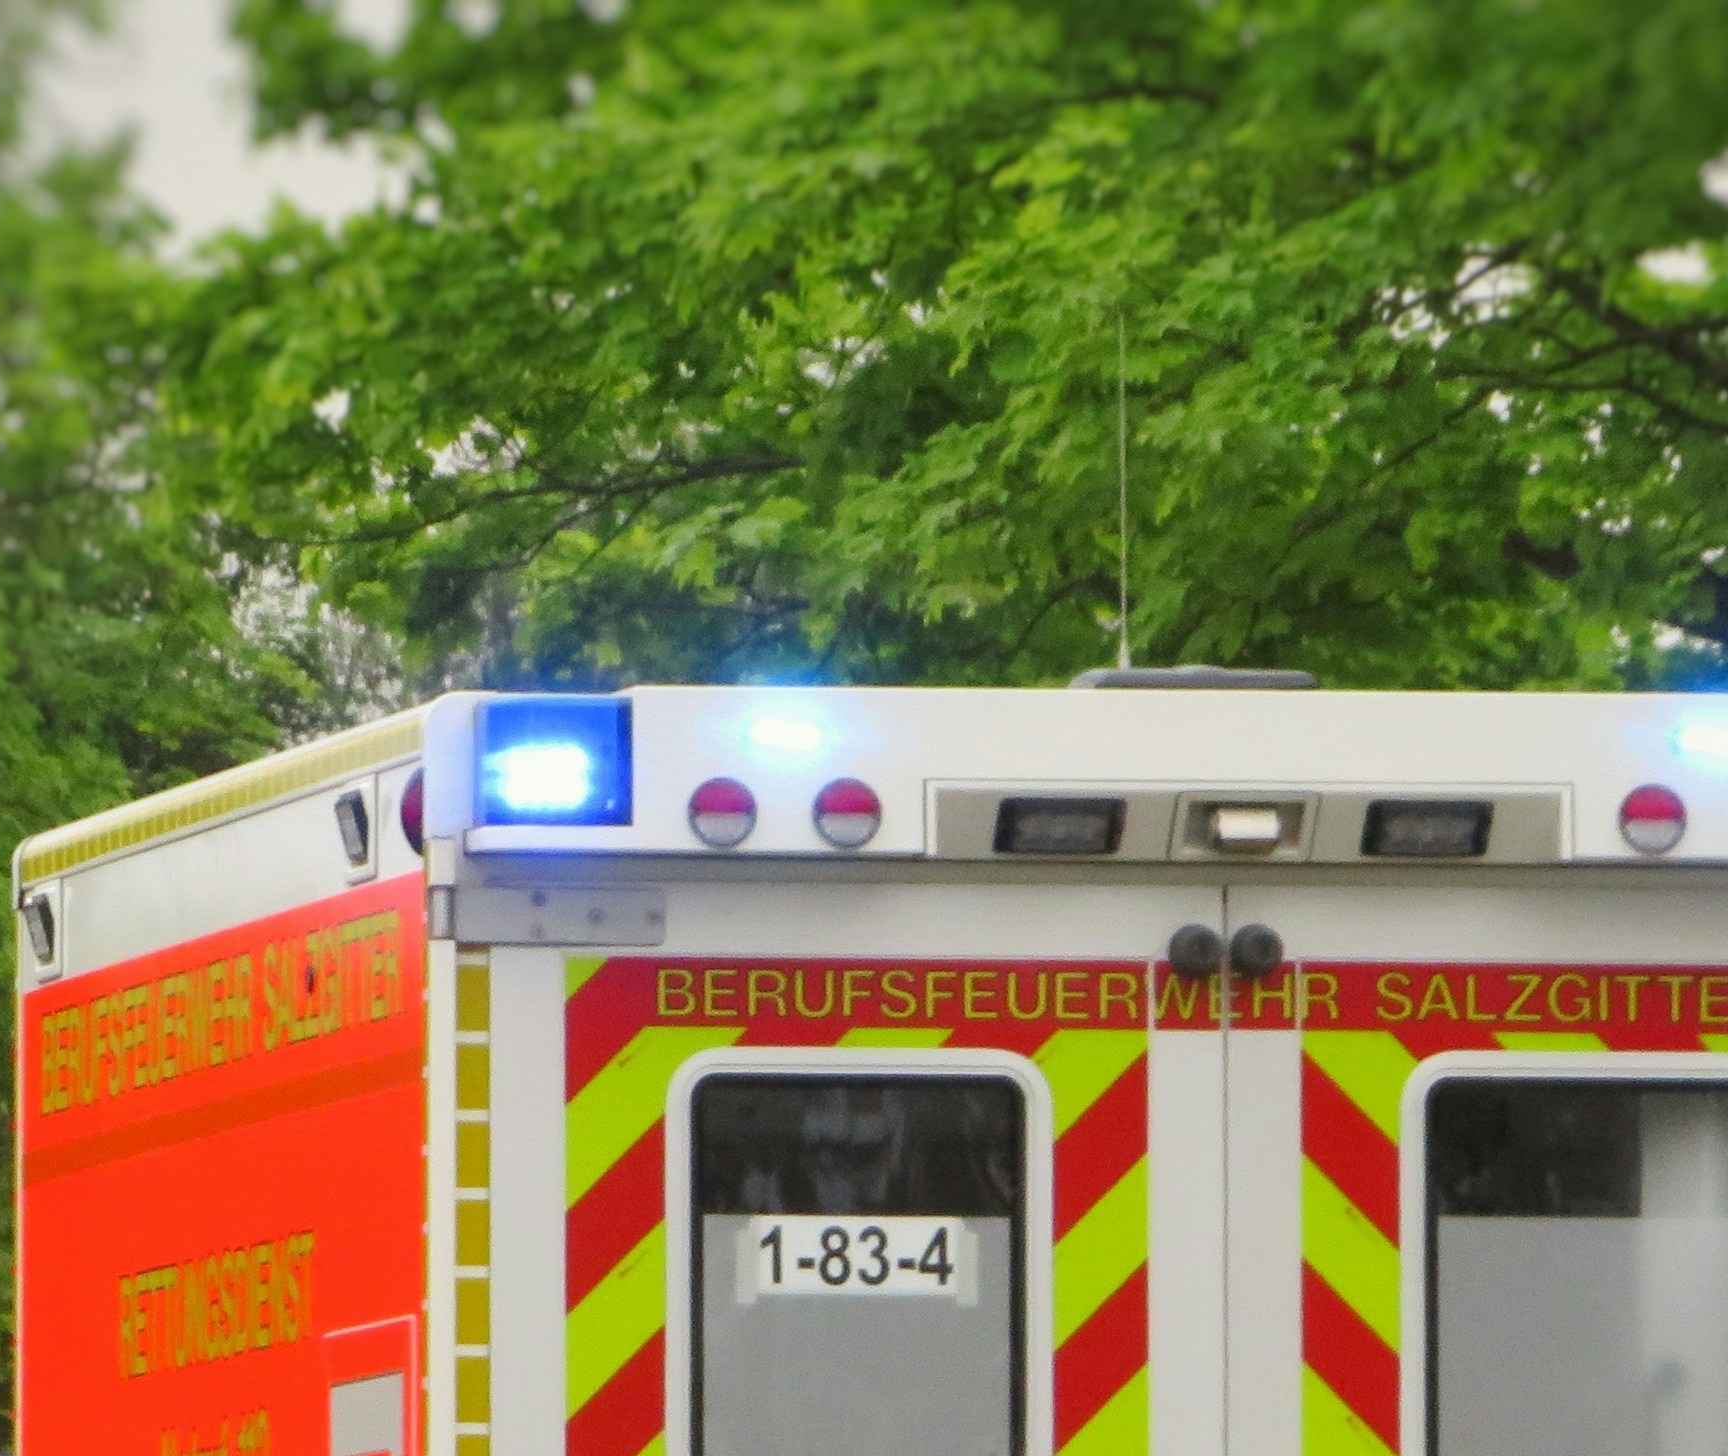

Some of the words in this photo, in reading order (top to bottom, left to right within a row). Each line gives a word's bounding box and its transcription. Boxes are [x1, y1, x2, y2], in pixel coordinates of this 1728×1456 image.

[40, 948, 253, 1117] BERUFSFEUERWEHR
[262, 907, 402, 1054] SALZGITTER
[656, 967, 1340, 1020] BERUFSFEUERWEHR
[119, 1229, 315, 1380] RETTUNGSDIENST
[759, 1224, 955, 1286] 1-83-4
